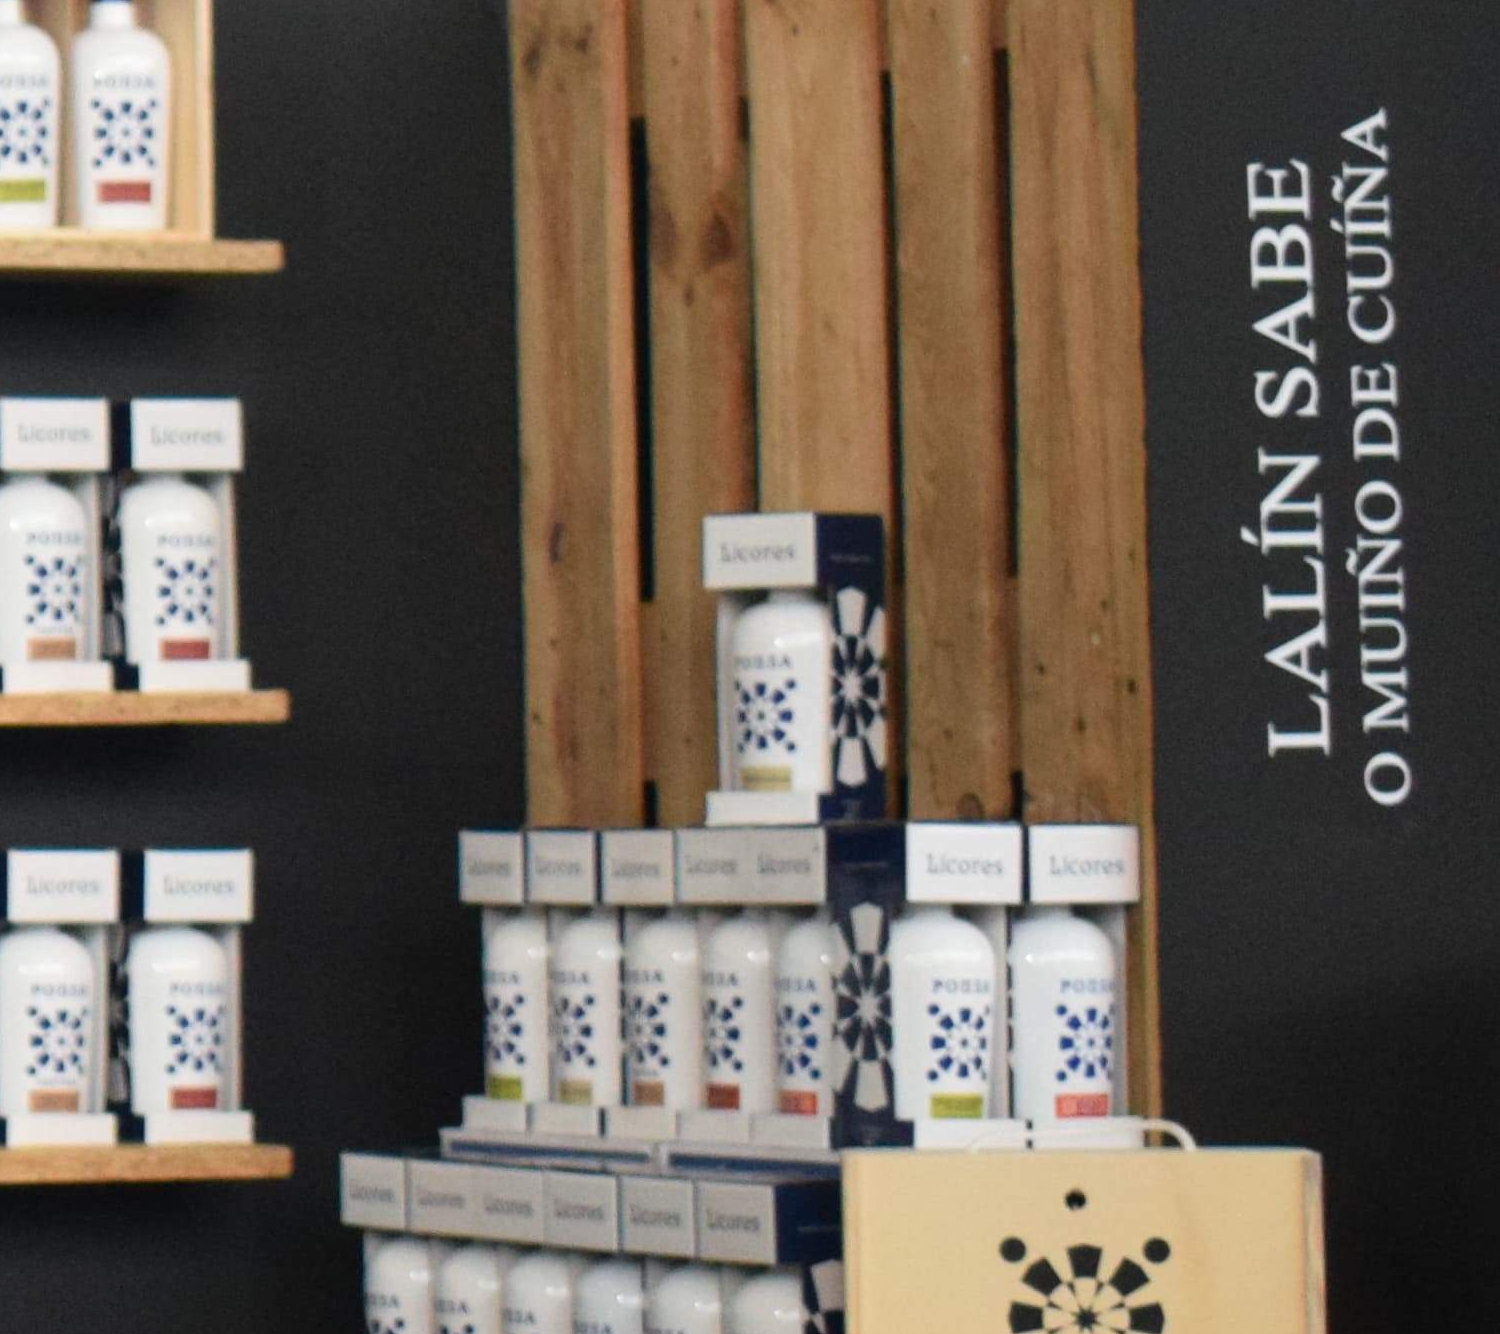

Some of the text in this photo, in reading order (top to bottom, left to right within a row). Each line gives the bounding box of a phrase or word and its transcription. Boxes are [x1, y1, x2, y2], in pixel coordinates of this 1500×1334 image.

[17, 422, 92, 444] Licores
[151, 424, 225, 446] Licores
[1241, 158, 1331, 758] LALÍN SABE
[1331, 109, 1412, 807] O MUIÑO DE CUÍÑA
[926, 853, 1003, 875] Licores
[1050, 854, 1124, 875] Licores
[26, 875, 100, 896] Licores
[163, 875, 235, 895] Licores
